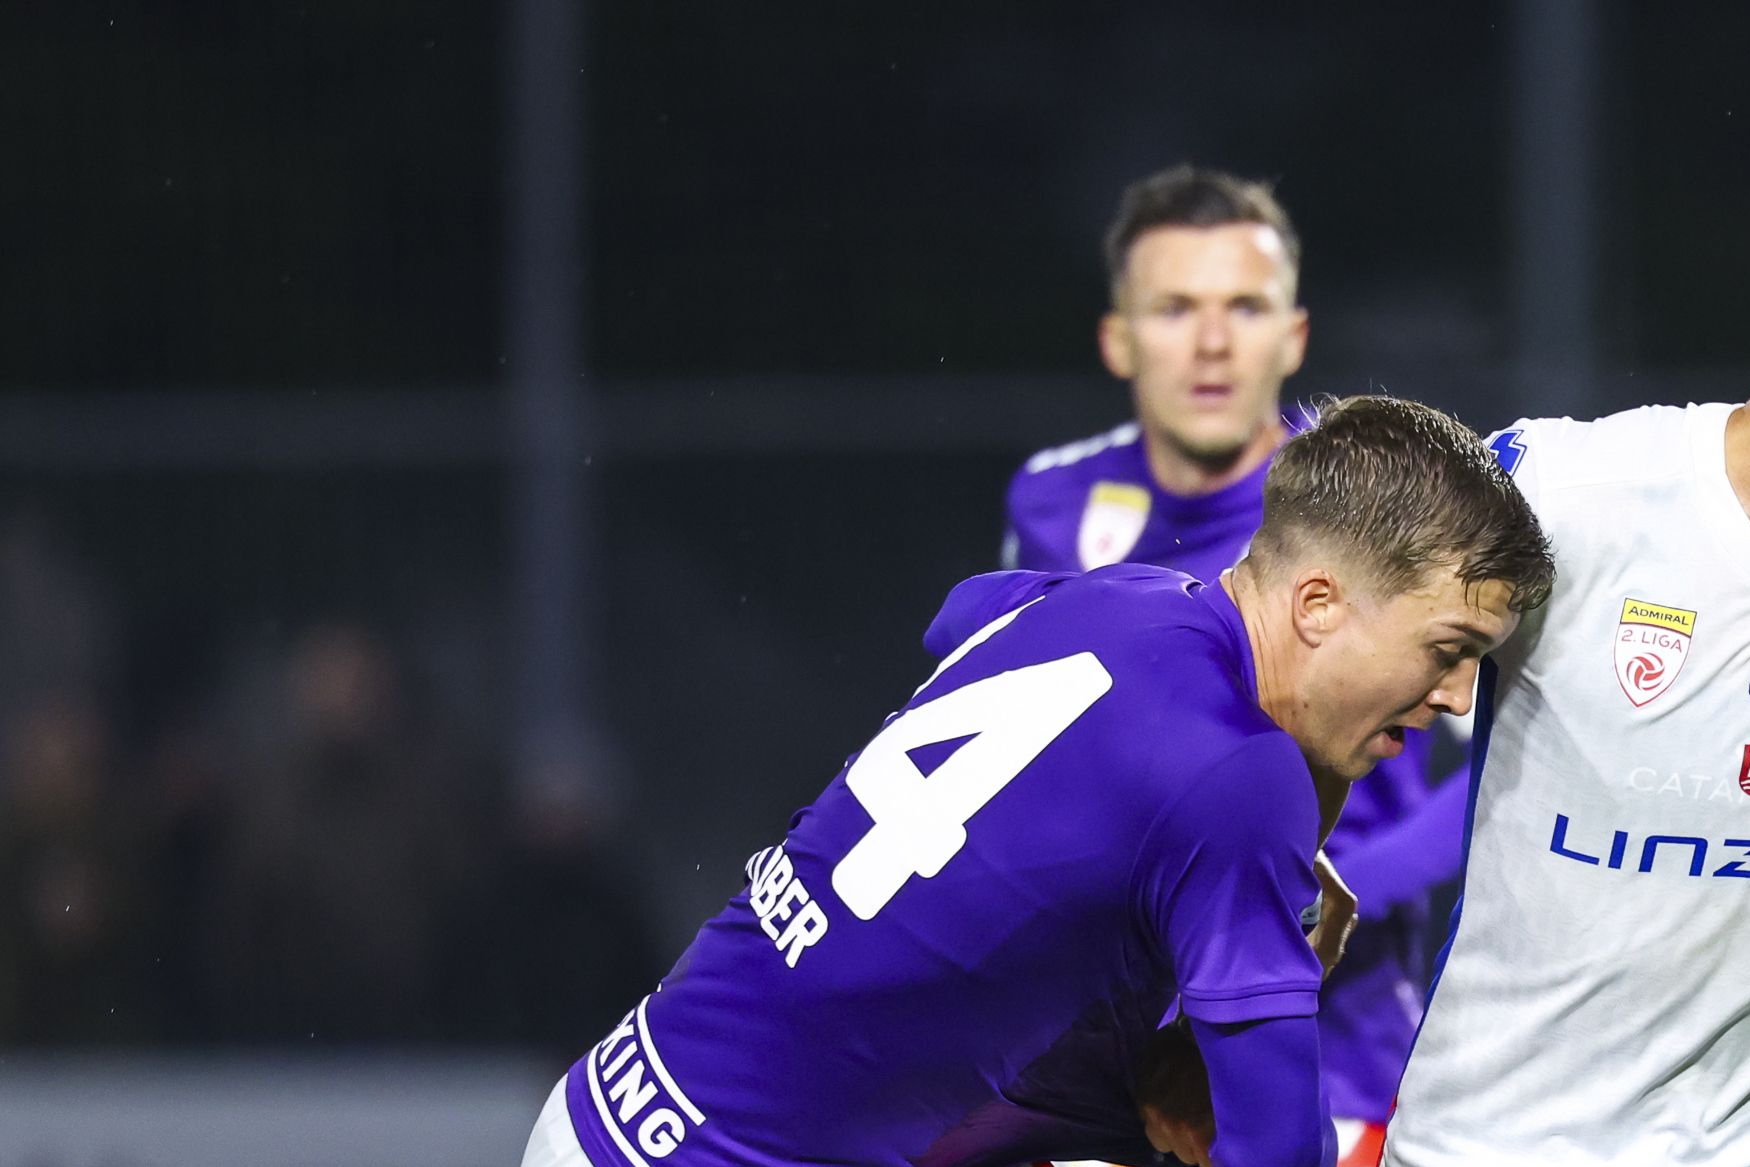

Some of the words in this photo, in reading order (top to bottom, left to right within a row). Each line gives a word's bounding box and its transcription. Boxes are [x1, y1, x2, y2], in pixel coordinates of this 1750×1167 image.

[1621, 629, 1636, 643] 2.
[1641, 632, 1683, 653] LIGA
[1628, 605, 1689, 626] ADMIRAL
[832, 596, 1113, 921] 4
[745, 845, 829, 968] UBER
[599, 1009, 686, 1158] KING
